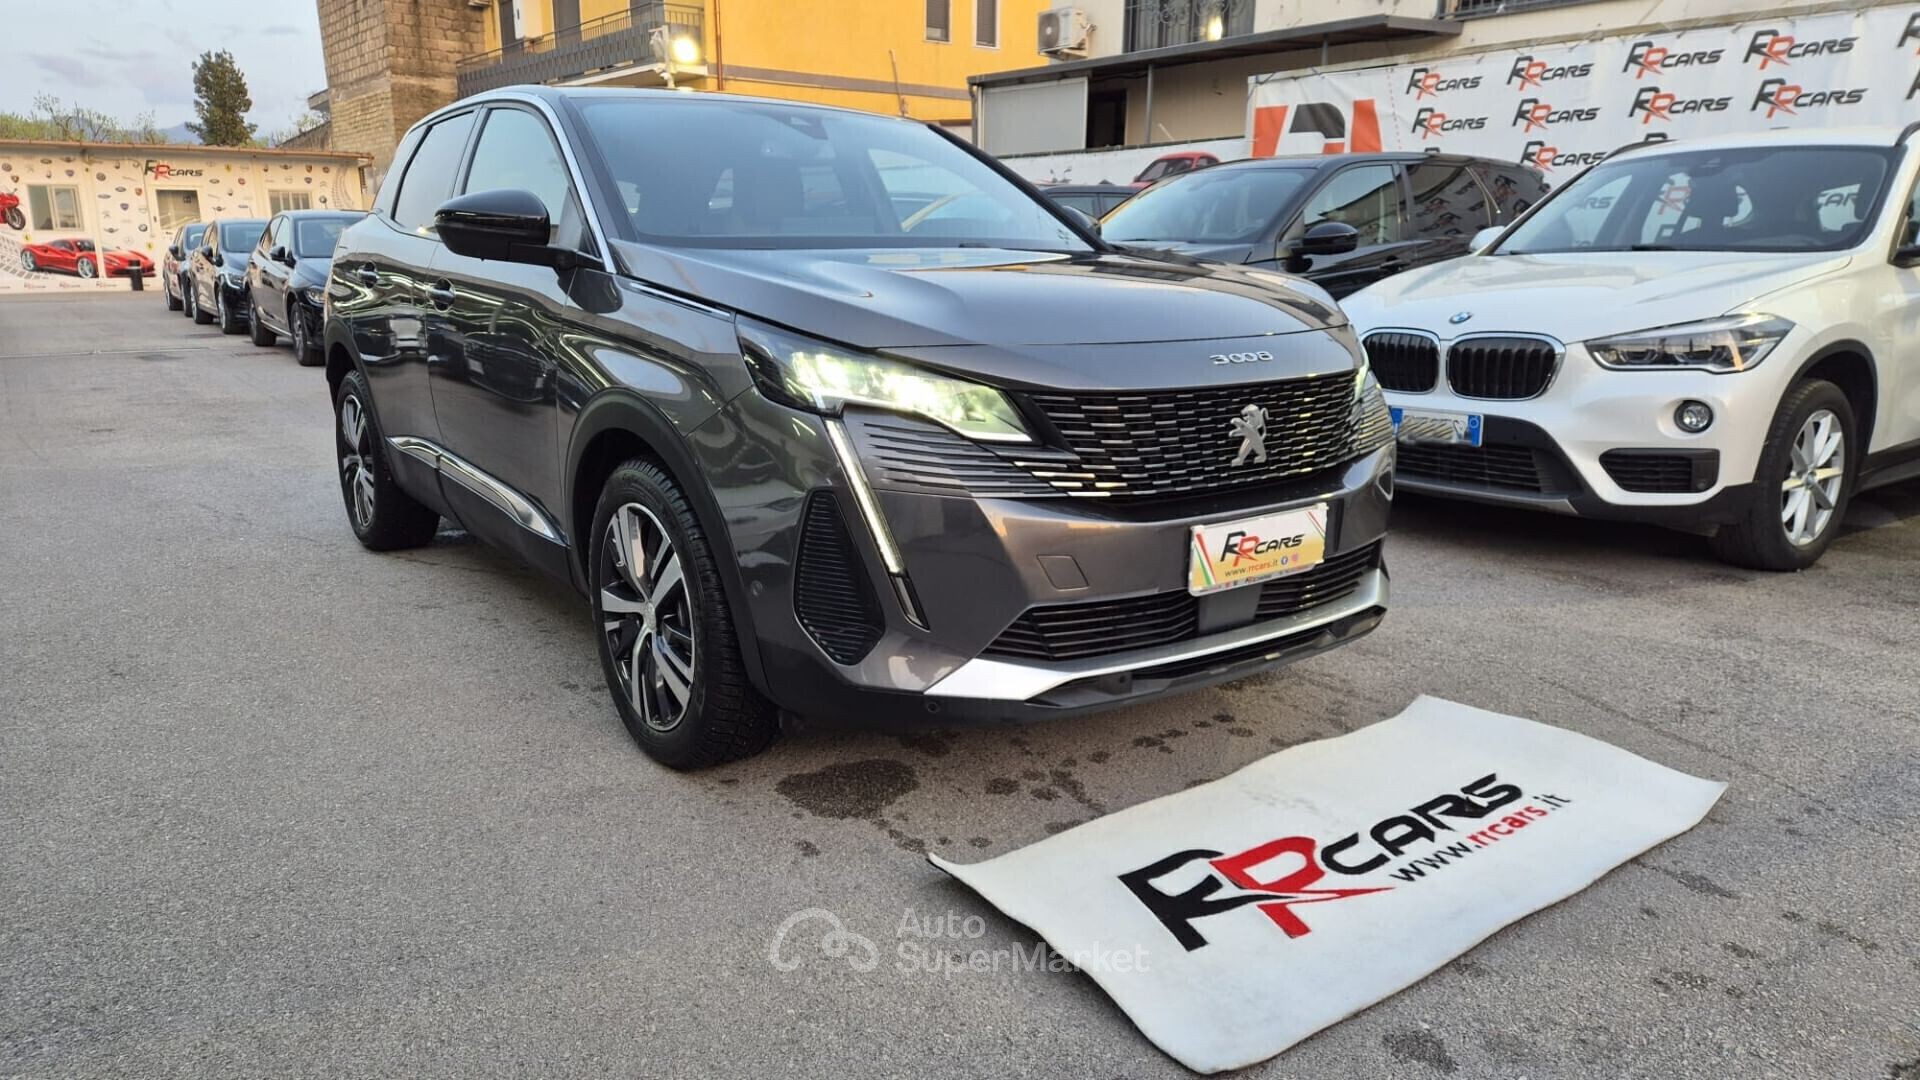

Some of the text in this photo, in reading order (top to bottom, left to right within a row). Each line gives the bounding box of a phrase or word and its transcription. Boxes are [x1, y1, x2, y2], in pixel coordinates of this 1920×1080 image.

[1209, 351, 1273, 365] 3008
[1224, 560, 1278, 577] www.rrcars.it
[1391, 791, 1573, 883] www.rrcars.it
